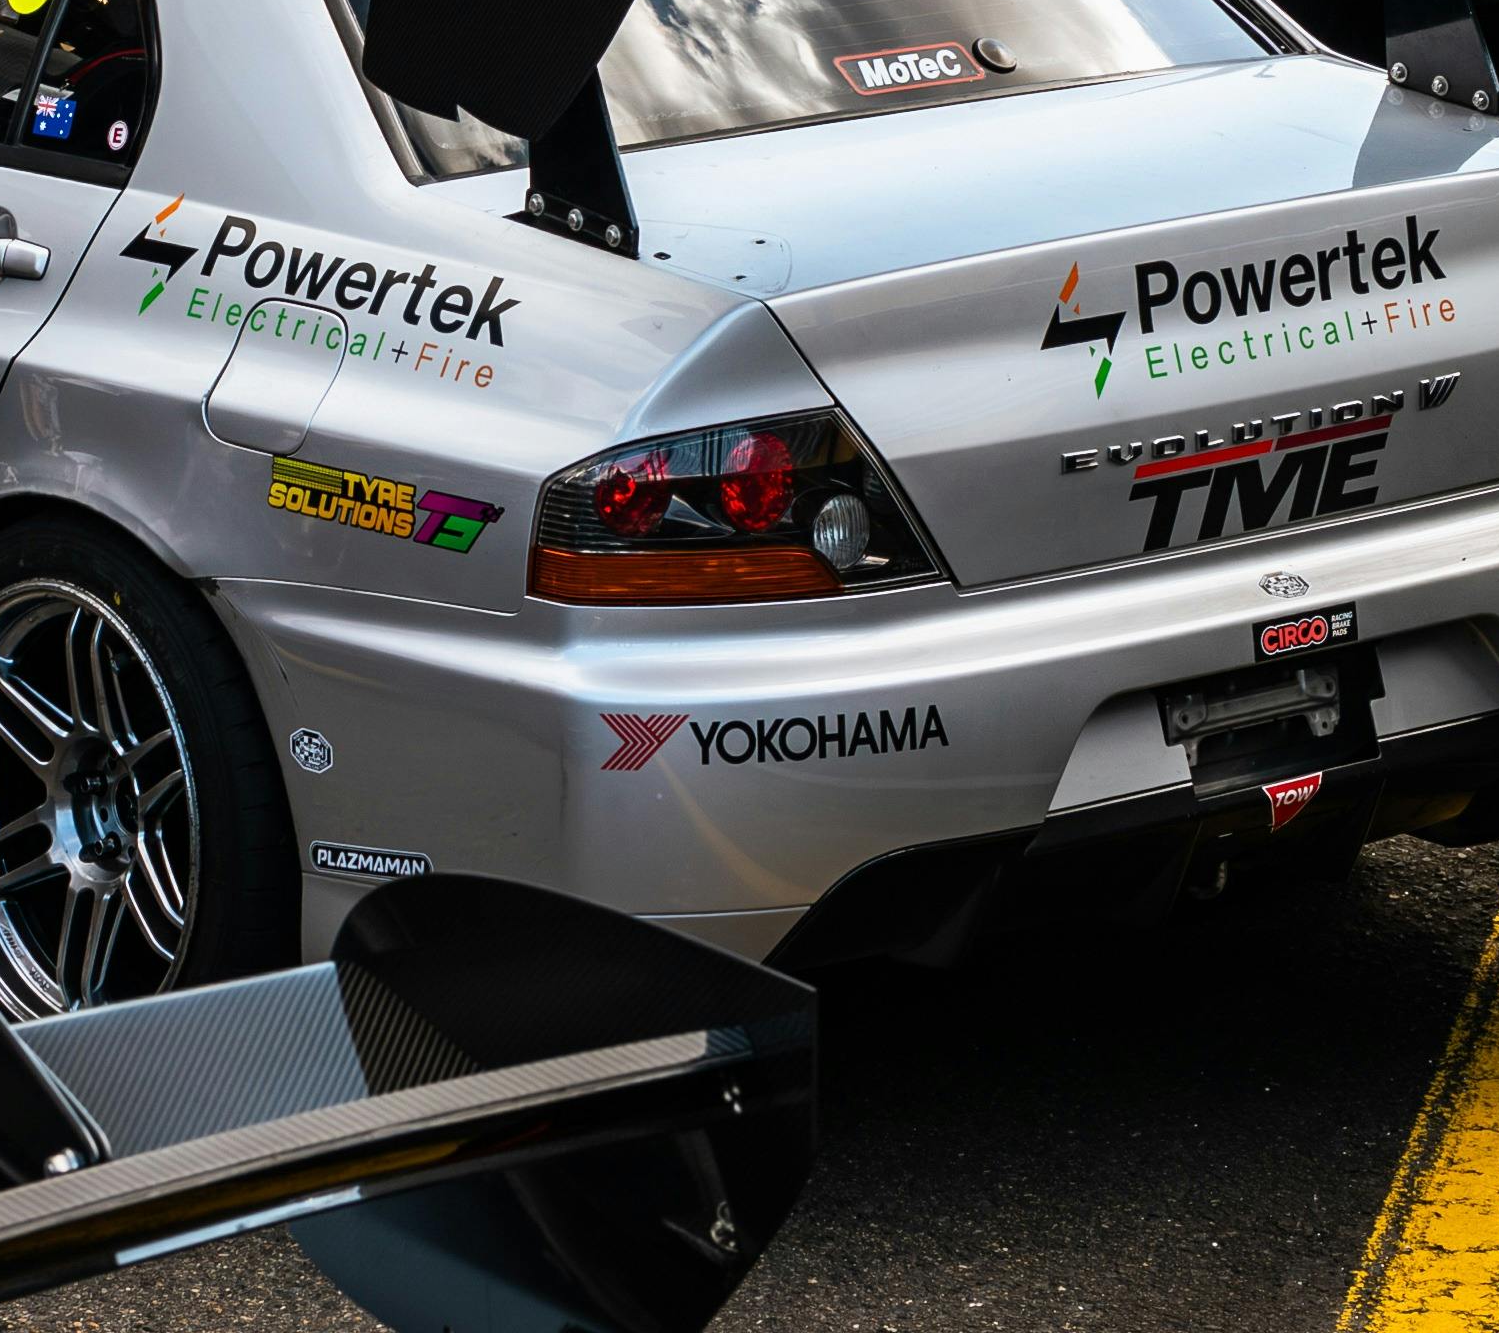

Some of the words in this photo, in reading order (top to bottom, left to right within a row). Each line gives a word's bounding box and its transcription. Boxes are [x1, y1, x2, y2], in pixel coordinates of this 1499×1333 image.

[857, 47, 963, 90] MoTeC
[200, 215, 522, 347] Powertek
[1135, 215, 1447, 336] Powertek
[1061, 390, 1406, 475] EVOLUTION
[268, 483, 414, 537] SOLUTIONS
[342, 472, 414, 508] TYRE
[1128, 433, 1395, 553] TME
[1263, 617, 1328, 654] CIRCO
[1331, 611, 1353, 624] RACING
[1332, 619, 1352, 631] BRAKE
[1332, 627, 1349, 638] PADS
[690, 703, 949, 766] YOKOHAMA
[1274, 783, 1315, 809] TOW
[315, 846, 427, 878] PLAZMAMAN
